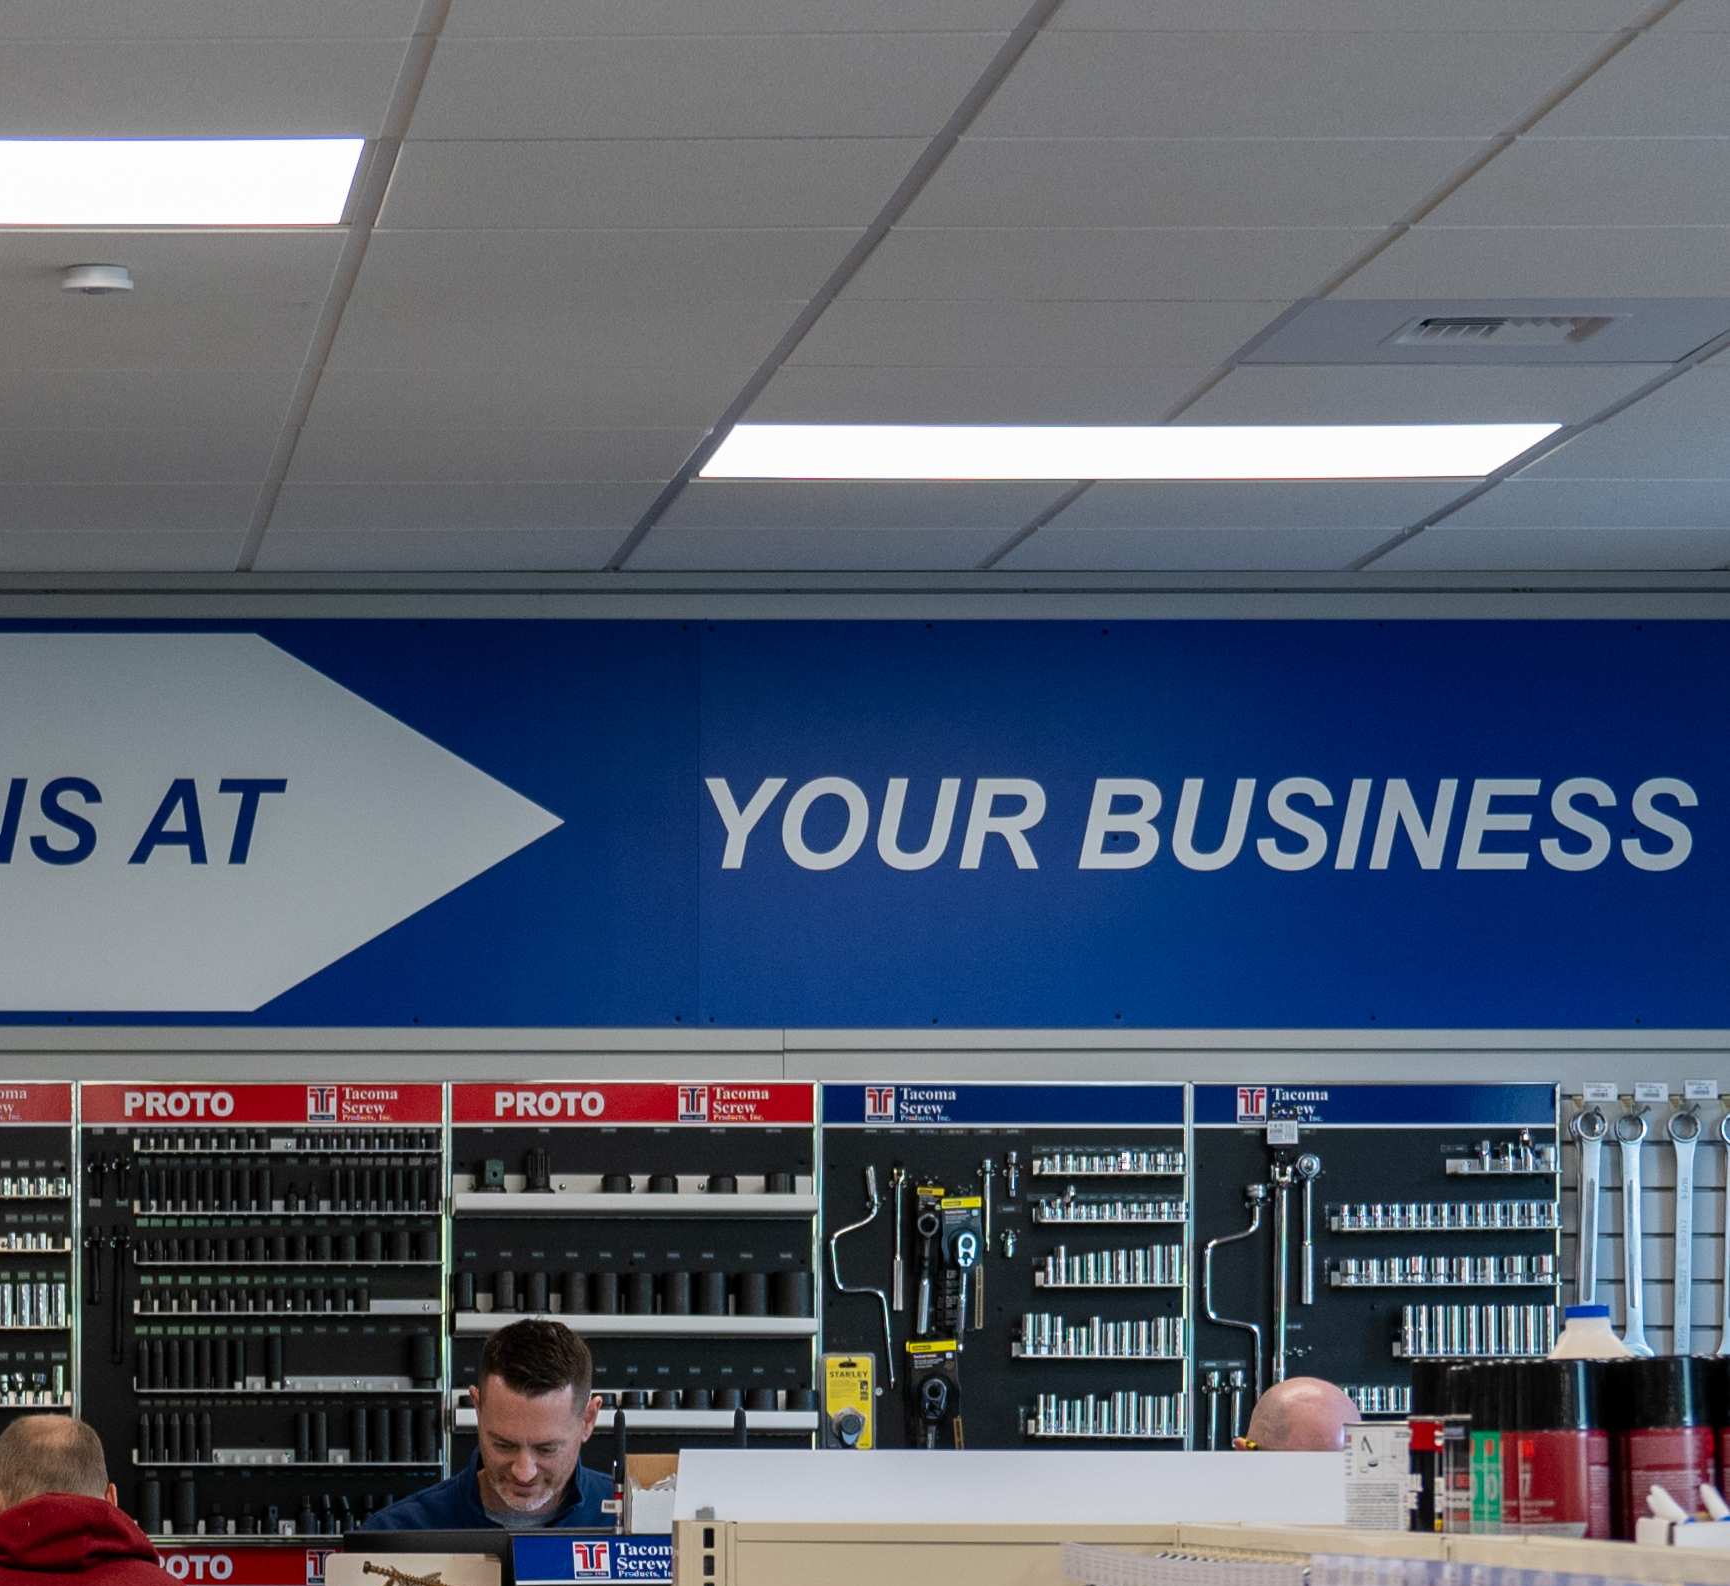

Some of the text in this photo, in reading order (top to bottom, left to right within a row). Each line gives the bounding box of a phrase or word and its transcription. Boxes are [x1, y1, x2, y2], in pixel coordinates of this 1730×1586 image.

[127, 777, 288, 865] AT
[704, 776, 1699, 872] YOUR BUSINESS
[341, 1086, 398, 1100] Tacoma
[712, 1086, 769, 1100] Tacoma
[900, 1087, 957, 1101] Tacoma
[1272, 1087, 1329, 1102] Tacoma
[123, 1091, 235, 1117] PROTO
[341, 1100, 385, 1113] Screw
[494, 1090, 606, 1117] PROTO
[712, 1100, 756, 1113] Screw
[900, 1101, 944, 1114] Screw
[901, 1113, 951, 1123] Products, Inc.
[616, 1542, 673, 1556] Tacom
[616, 1557, 670, 1570] Screw
[618, 1570, 660, 1578] Products,
